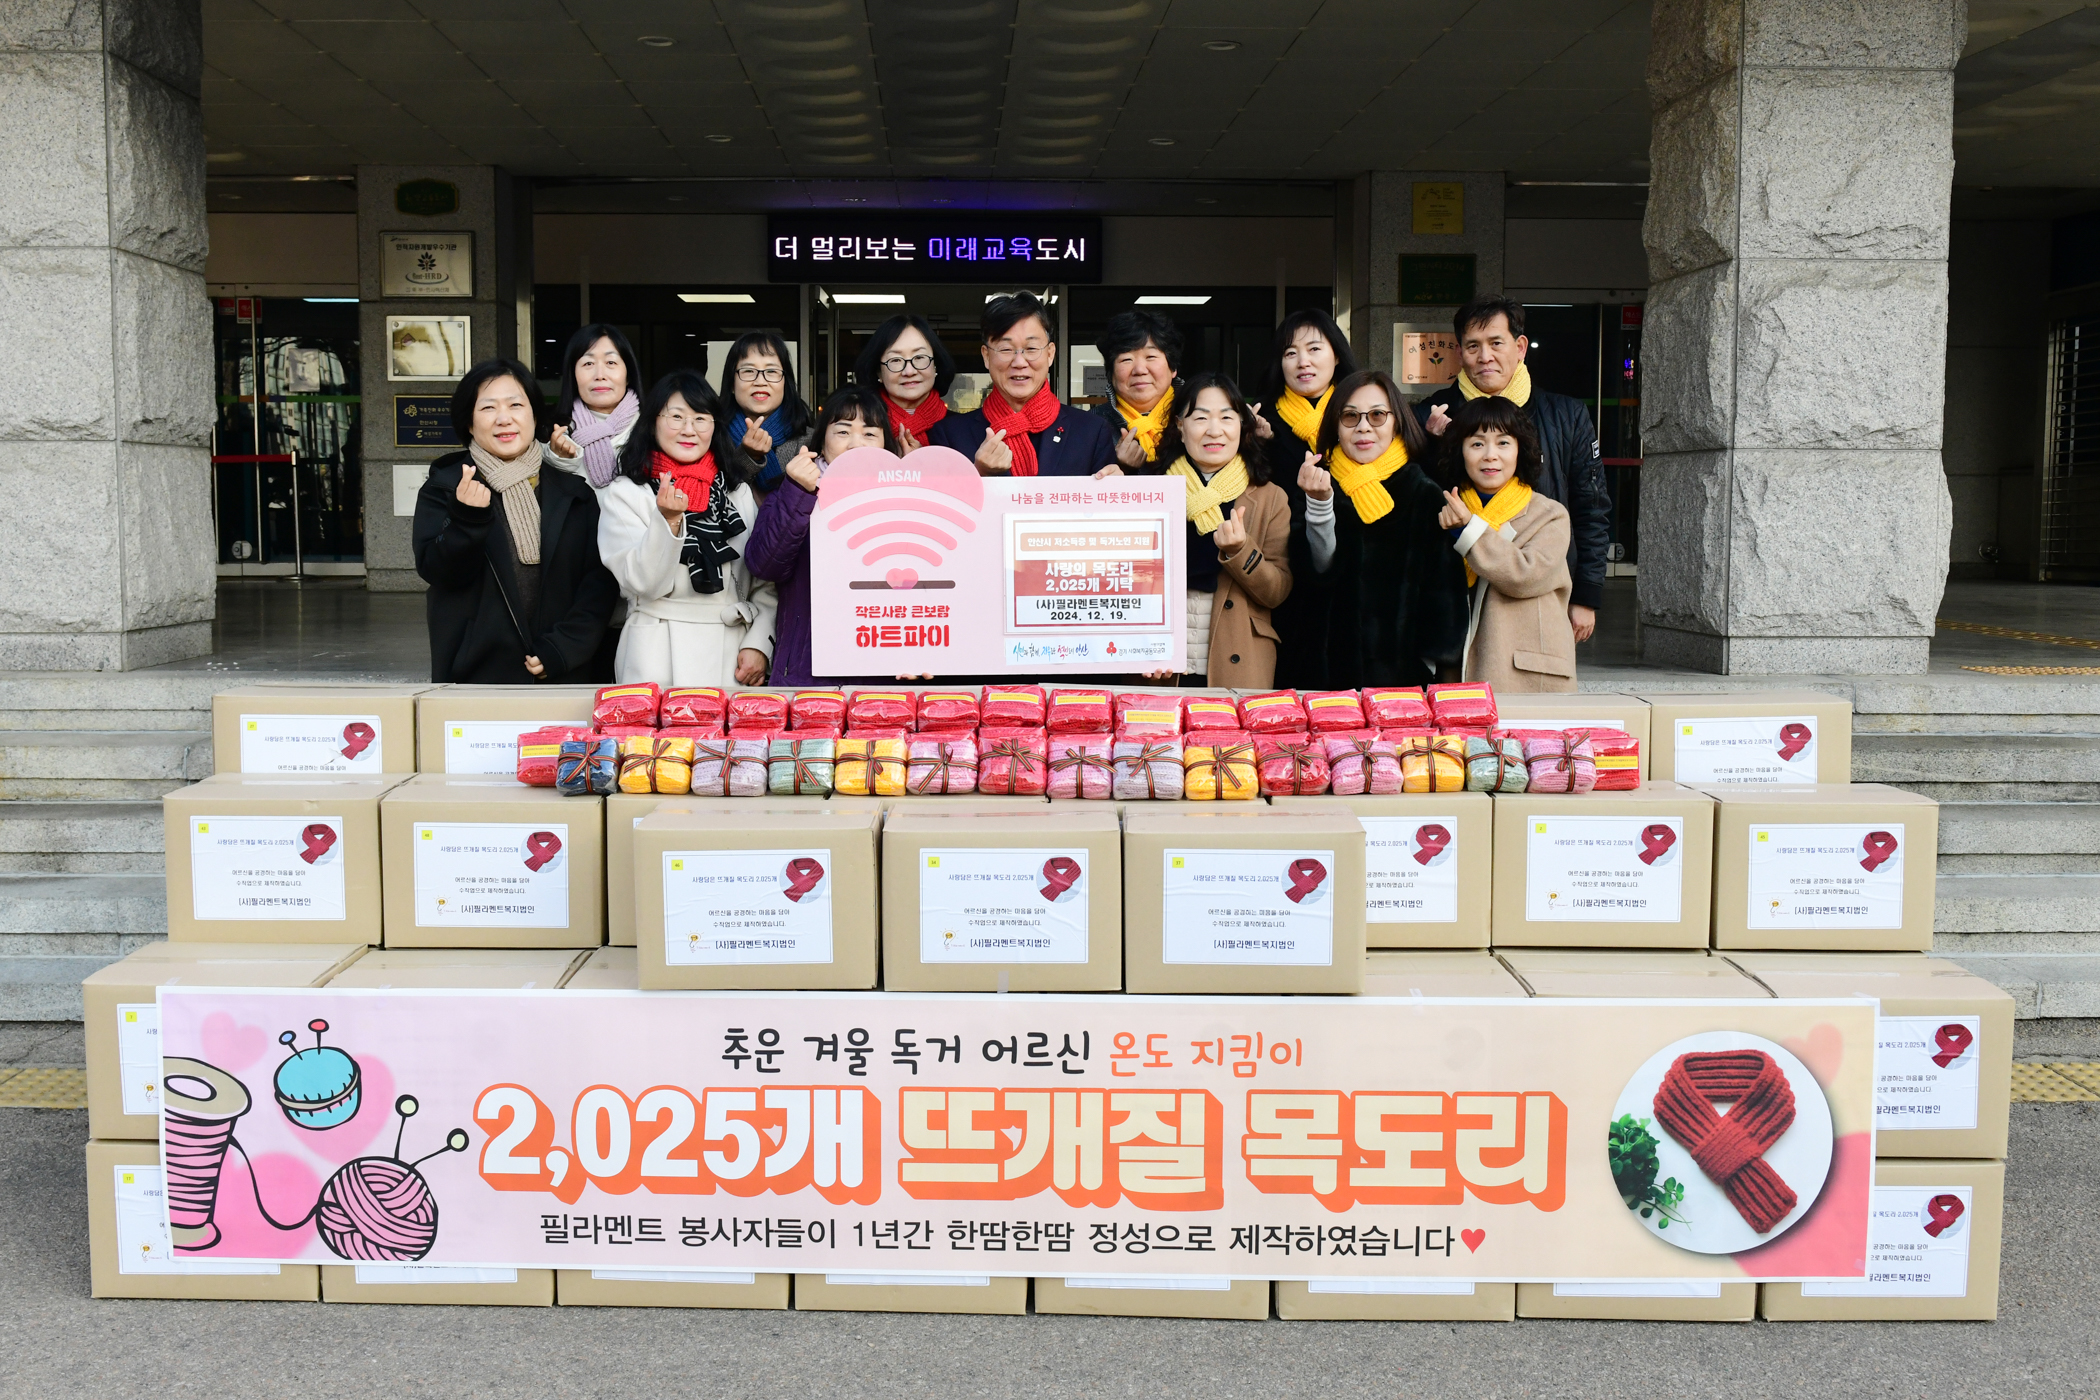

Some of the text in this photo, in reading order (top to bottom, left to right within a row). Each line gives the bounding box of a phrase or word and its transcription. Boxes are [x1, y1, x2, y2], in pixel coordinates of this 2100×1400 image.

[775, 236, 1085, 262] 더 멀리보는 미래교육도시
[1408, 340, 1455, 353] 여성친화도
[878, 471, 921, 483] ANSAN
[1012, 492, 1164, 505] 나눔을 전파하는 따뜻한에너지
[1028, 536, 1150, 547] 안산시 저소득층 및 독거노인 지원
[1045, 561, 1134, 577] 사랑의 목도리
[1045, 577, 1134, 593] 2,025개 기탁
[1036, 598, 1141, 610] (사)필라멘트복지법인
[855, 605, 950, 618] 작은사랑 큰보람
[1051, 611, 1127, 621] 2024. 12. 19.
[856, 624, 950, 648] 하트파이
[722, 1028, 1302, 1078] 추운 겨울 독거 어르신 온도 지킴이
[474, 1084, 1567, 1211] 2,025개 뜨개질 목도리
[540, 1214, 1456, 1257] 필라멘트 봉사자들이 1년간 한땀한땀 정성으로 제작하였습니다
